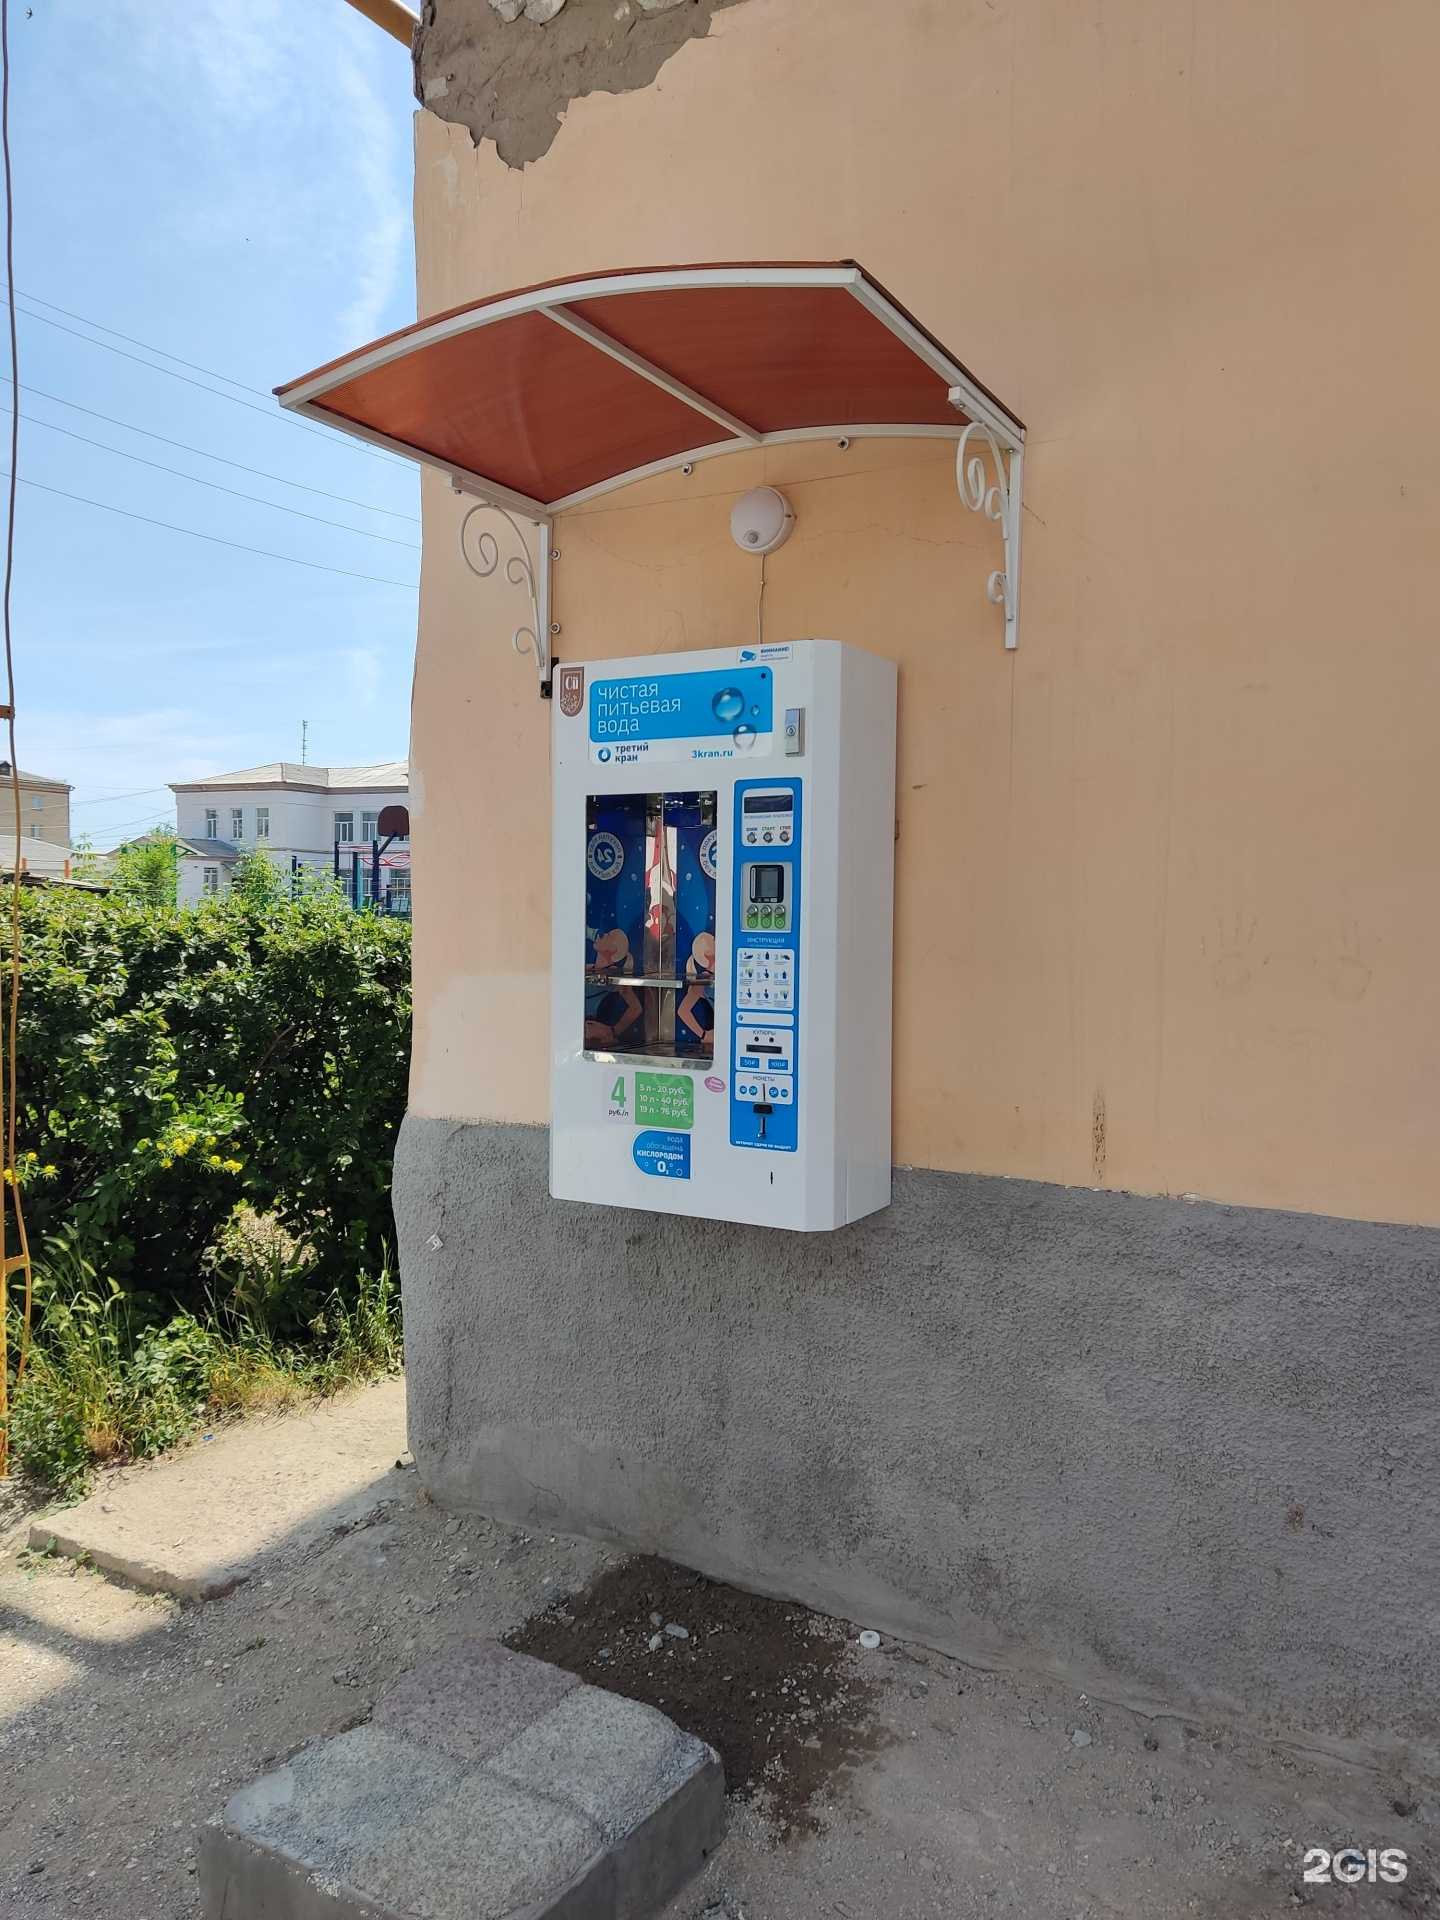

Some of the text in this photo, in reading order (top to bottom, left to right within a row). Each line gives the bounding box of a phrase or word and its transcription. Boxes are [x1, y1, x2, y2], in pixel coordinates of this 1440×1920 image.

[598, 683, 658, 700] чистая
[598, 698, 681, 717] питьевая
[598, 718, 640, 736] вода
[615, 742, 649, 755] третий
[691, 749, 733, 759] 3kran.ru
[615, 754, 638, 764] кран
[611, 1076, 627, 1108] 4
[636, 1149, 684, 1160] КИСЛОРОДОМ
